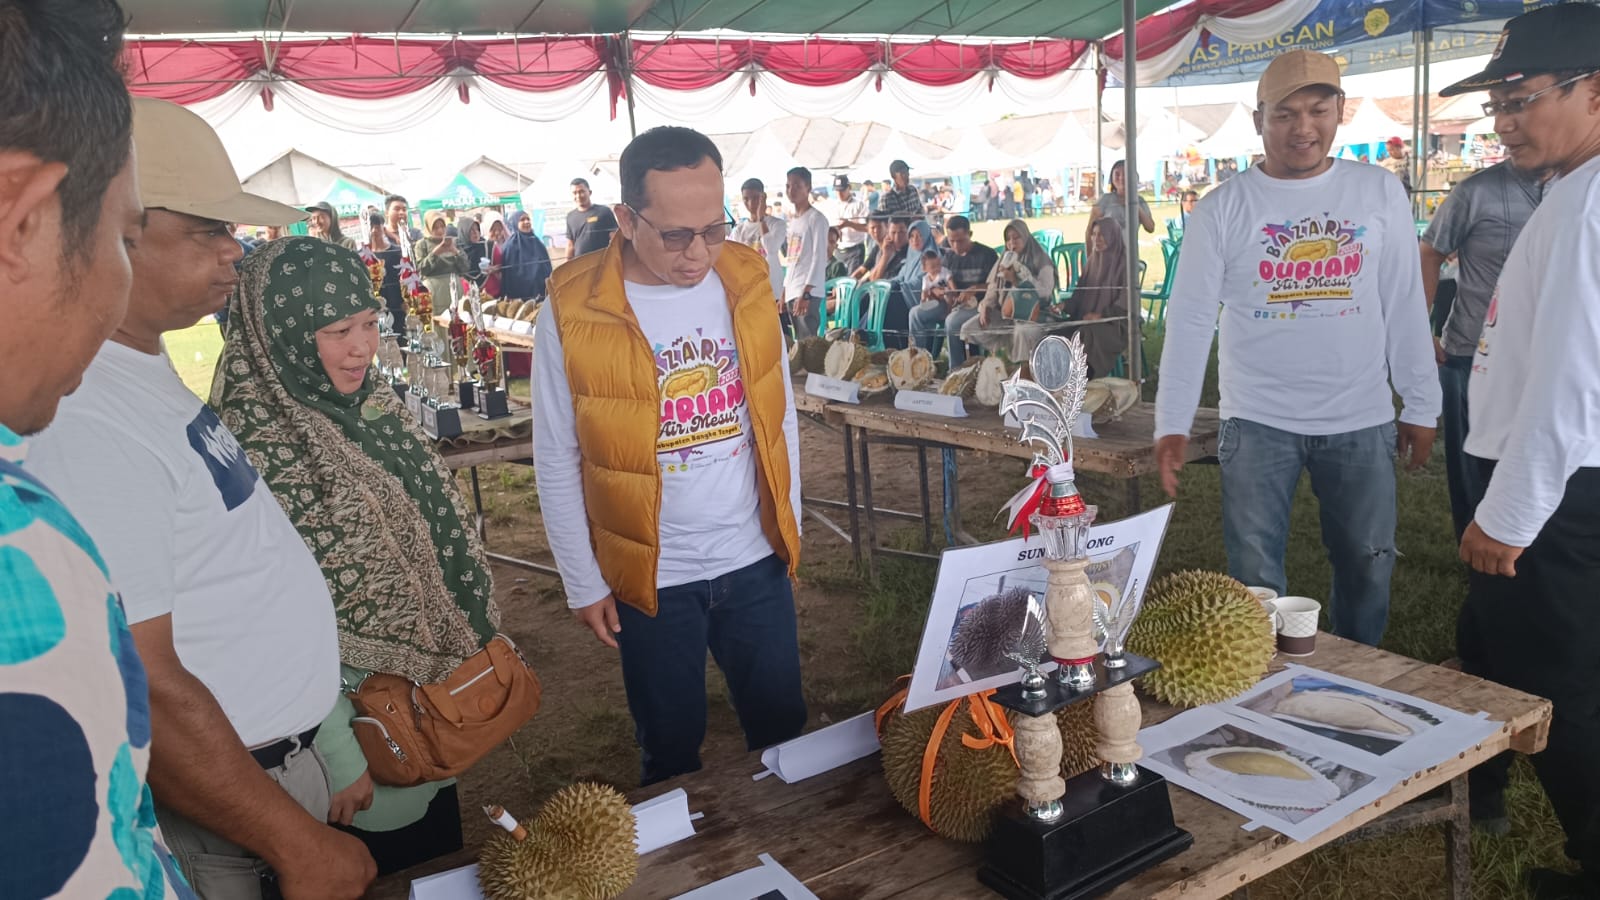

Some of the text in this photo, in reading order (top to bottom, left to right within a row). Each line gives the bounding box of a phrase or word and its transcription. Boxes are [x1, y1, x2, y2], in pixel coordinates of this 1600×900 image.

[1184, 20, 1334, 64] AS PANGAN
[1266, 220, 1339, 258] BAZAR
[1259, 253, 1362, 281] DURIAN
[659, 338, 716, 373] ZAR
[660, 379, 744, 423] URIAN
[656, 437, 691, 450] abupaten
[691, 430, 717, 441] Bangka
[658, 420, 685, 438] Air
